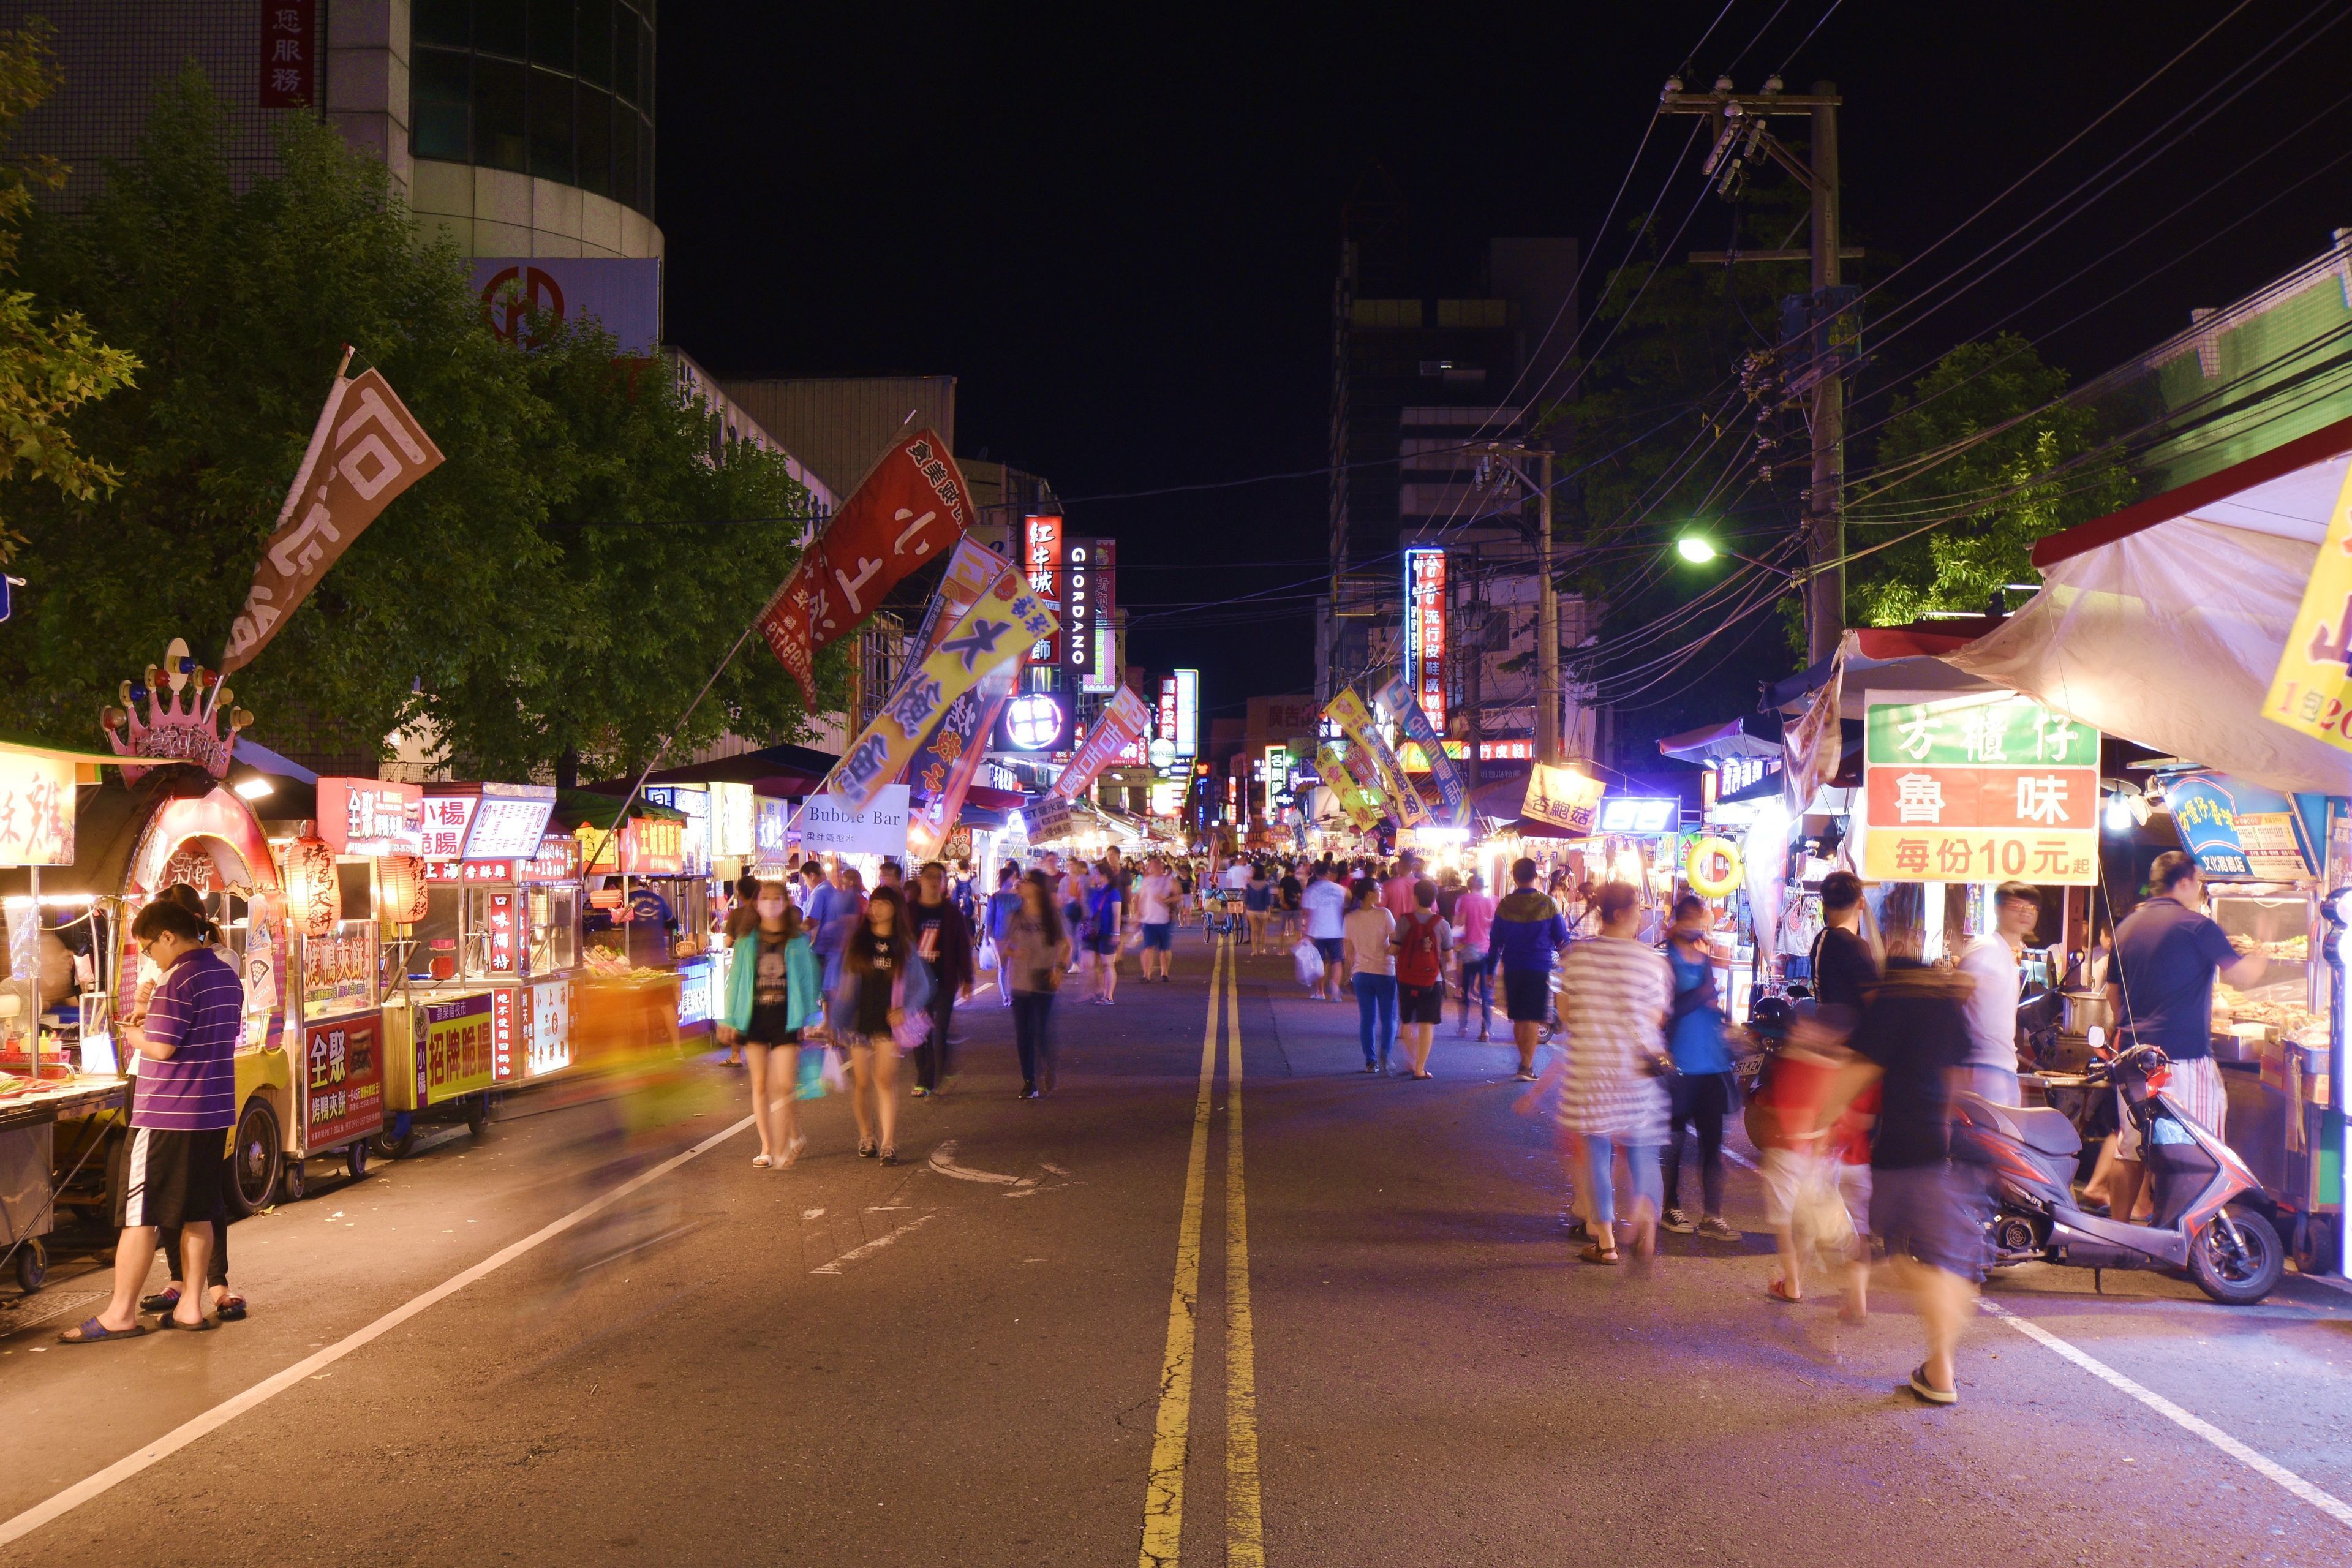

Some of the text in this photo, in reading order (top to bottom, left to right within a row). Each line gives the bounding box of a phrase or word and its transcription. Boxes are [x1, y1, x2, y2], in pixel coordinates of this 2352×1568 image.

[271, 0, 303, 92] 您服務
[1029, 521, 1055, 597] 紅牛城
[1072, 547, 1086, 665] GIORDANO
[1463, 743, 1536, 760] 流行皮鞋
[1897, 709, 2079, 762] 方櫃仔
[422, 801, 465, 825] 小楊
[873, 810, 900, 826] Bar
[1532, 794, 1592, 826] 杏鮑菇
[1894, 772, 2070, 825] 魯味
[425, 862, 459, 879] 上海
[1896, 837, 2090, 875] 每份10元起
[301, 843, 334, 930] 烤鴨夾餅
[305, 937, 364, 989] 烤鴨夾餅
[535, 986, 567, 1008] 小上海
[310, 1030, 346, 1088] 全聚
[417, 1047, 426, 1095] 小楊
[429, 1022, 491, 1088] 招牌脆腸
[311, 1090, 346, 1125] 烤鴨夾餅
